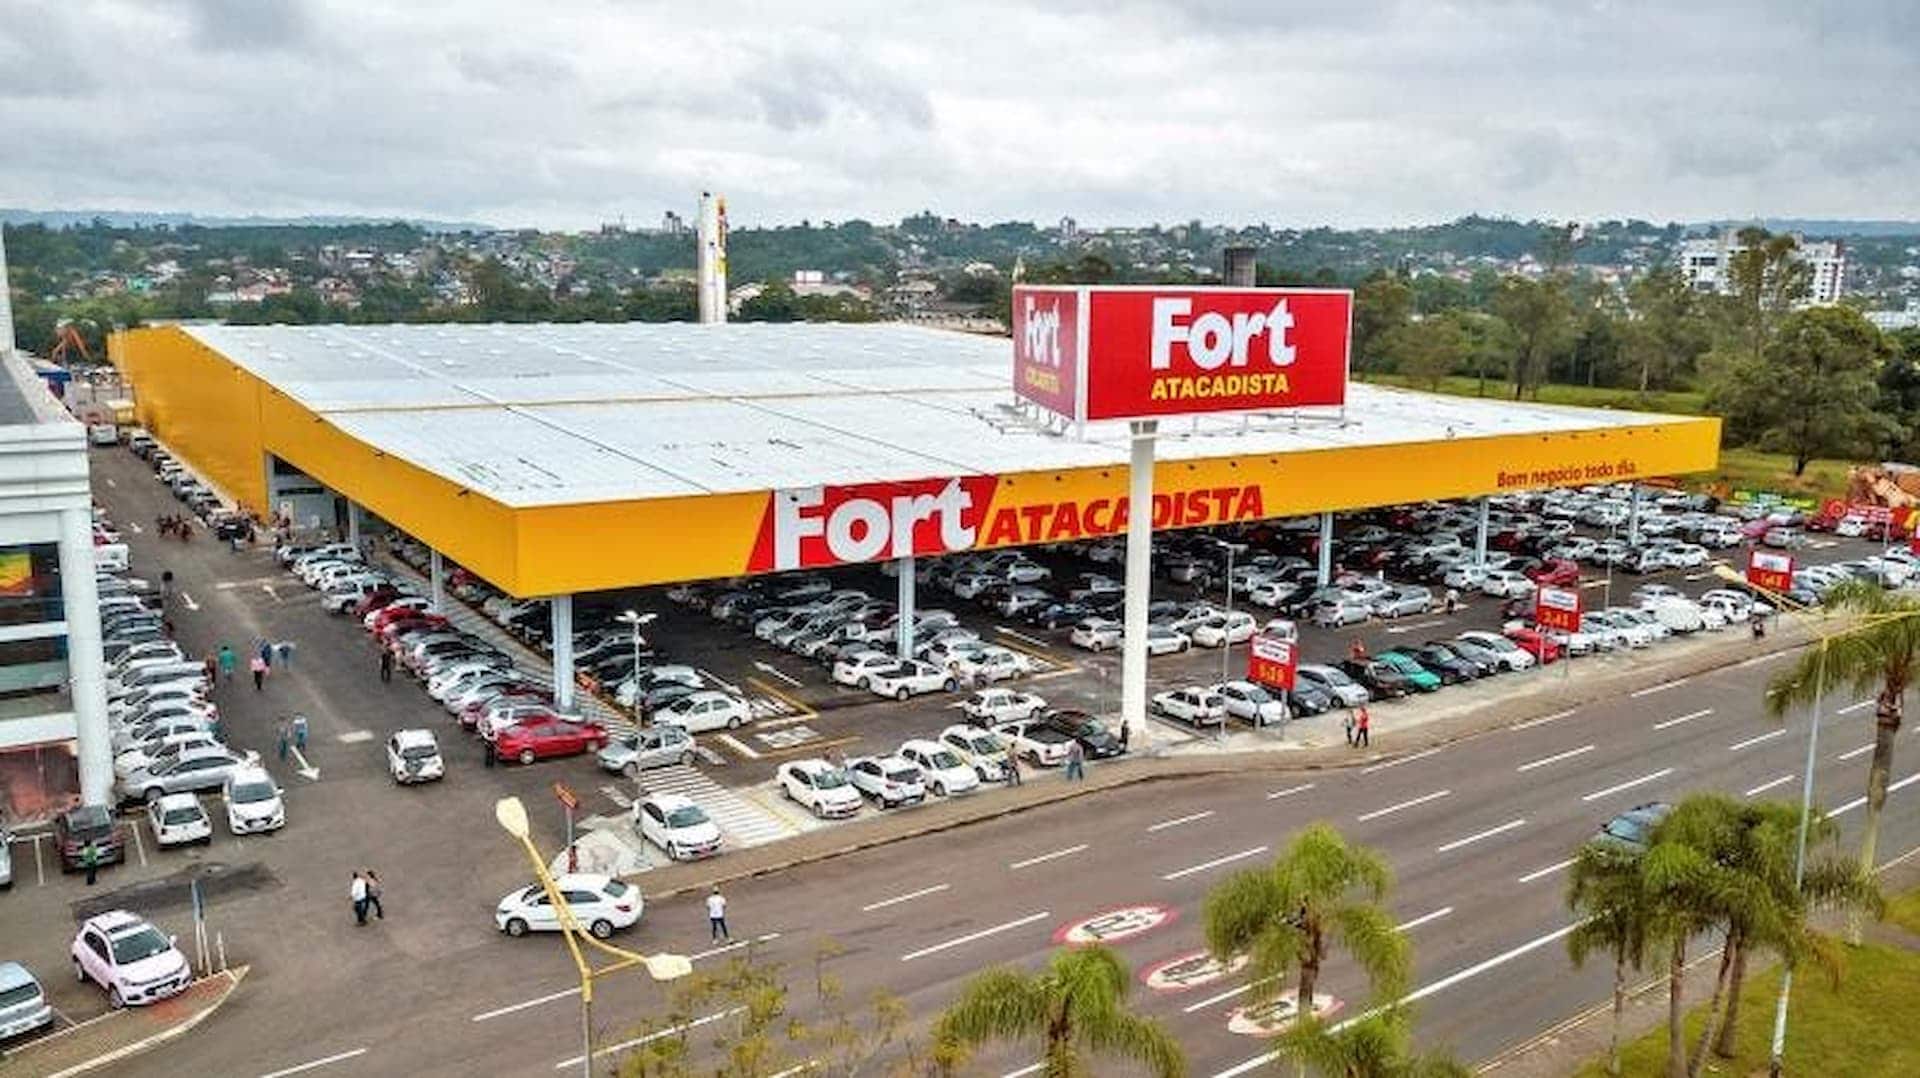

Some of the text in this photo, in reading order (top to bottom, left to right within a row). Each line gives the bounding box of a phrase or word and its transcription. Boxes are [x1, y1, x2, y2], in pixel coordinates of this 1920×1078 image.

[1024, 296, 1061, 368] Fort
[1151, 297, 1297, 370] Fort
[1151, 373, 1290, 400] ATACADISTA
[774, 477, 1262, 570] Fort ATACADISTA
